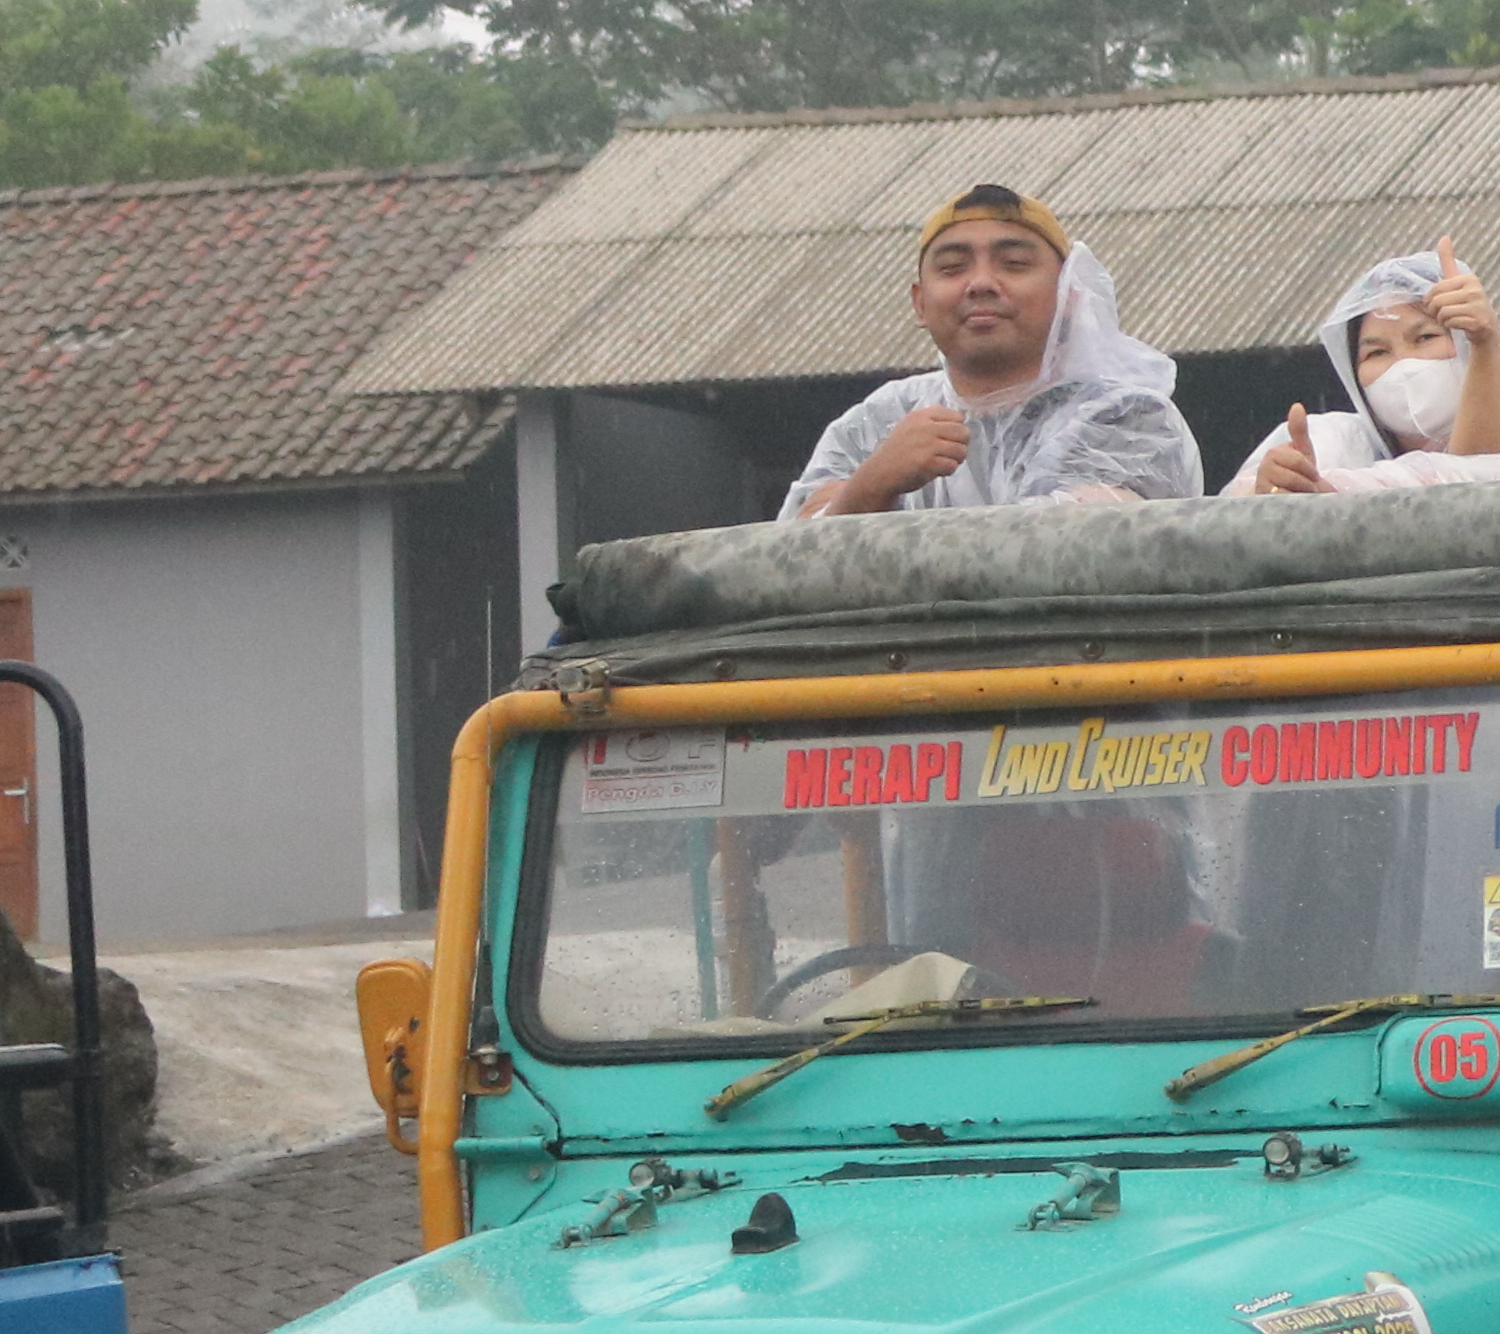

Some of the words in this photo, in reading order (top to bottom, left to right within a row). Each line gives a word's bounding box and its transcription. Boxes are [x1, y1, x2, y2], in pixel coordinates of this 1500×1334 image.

[784, 742, 963, 809] MERAPI
[978, 725, 1060, 797] LAND
[1068, 718, 1208, 792] CRUISER
[1220, 712, 1480, 786] COMMUNITY
[586, 786, 664, 802] Pengda
[1430, 1032, 1487, 1077] 05
